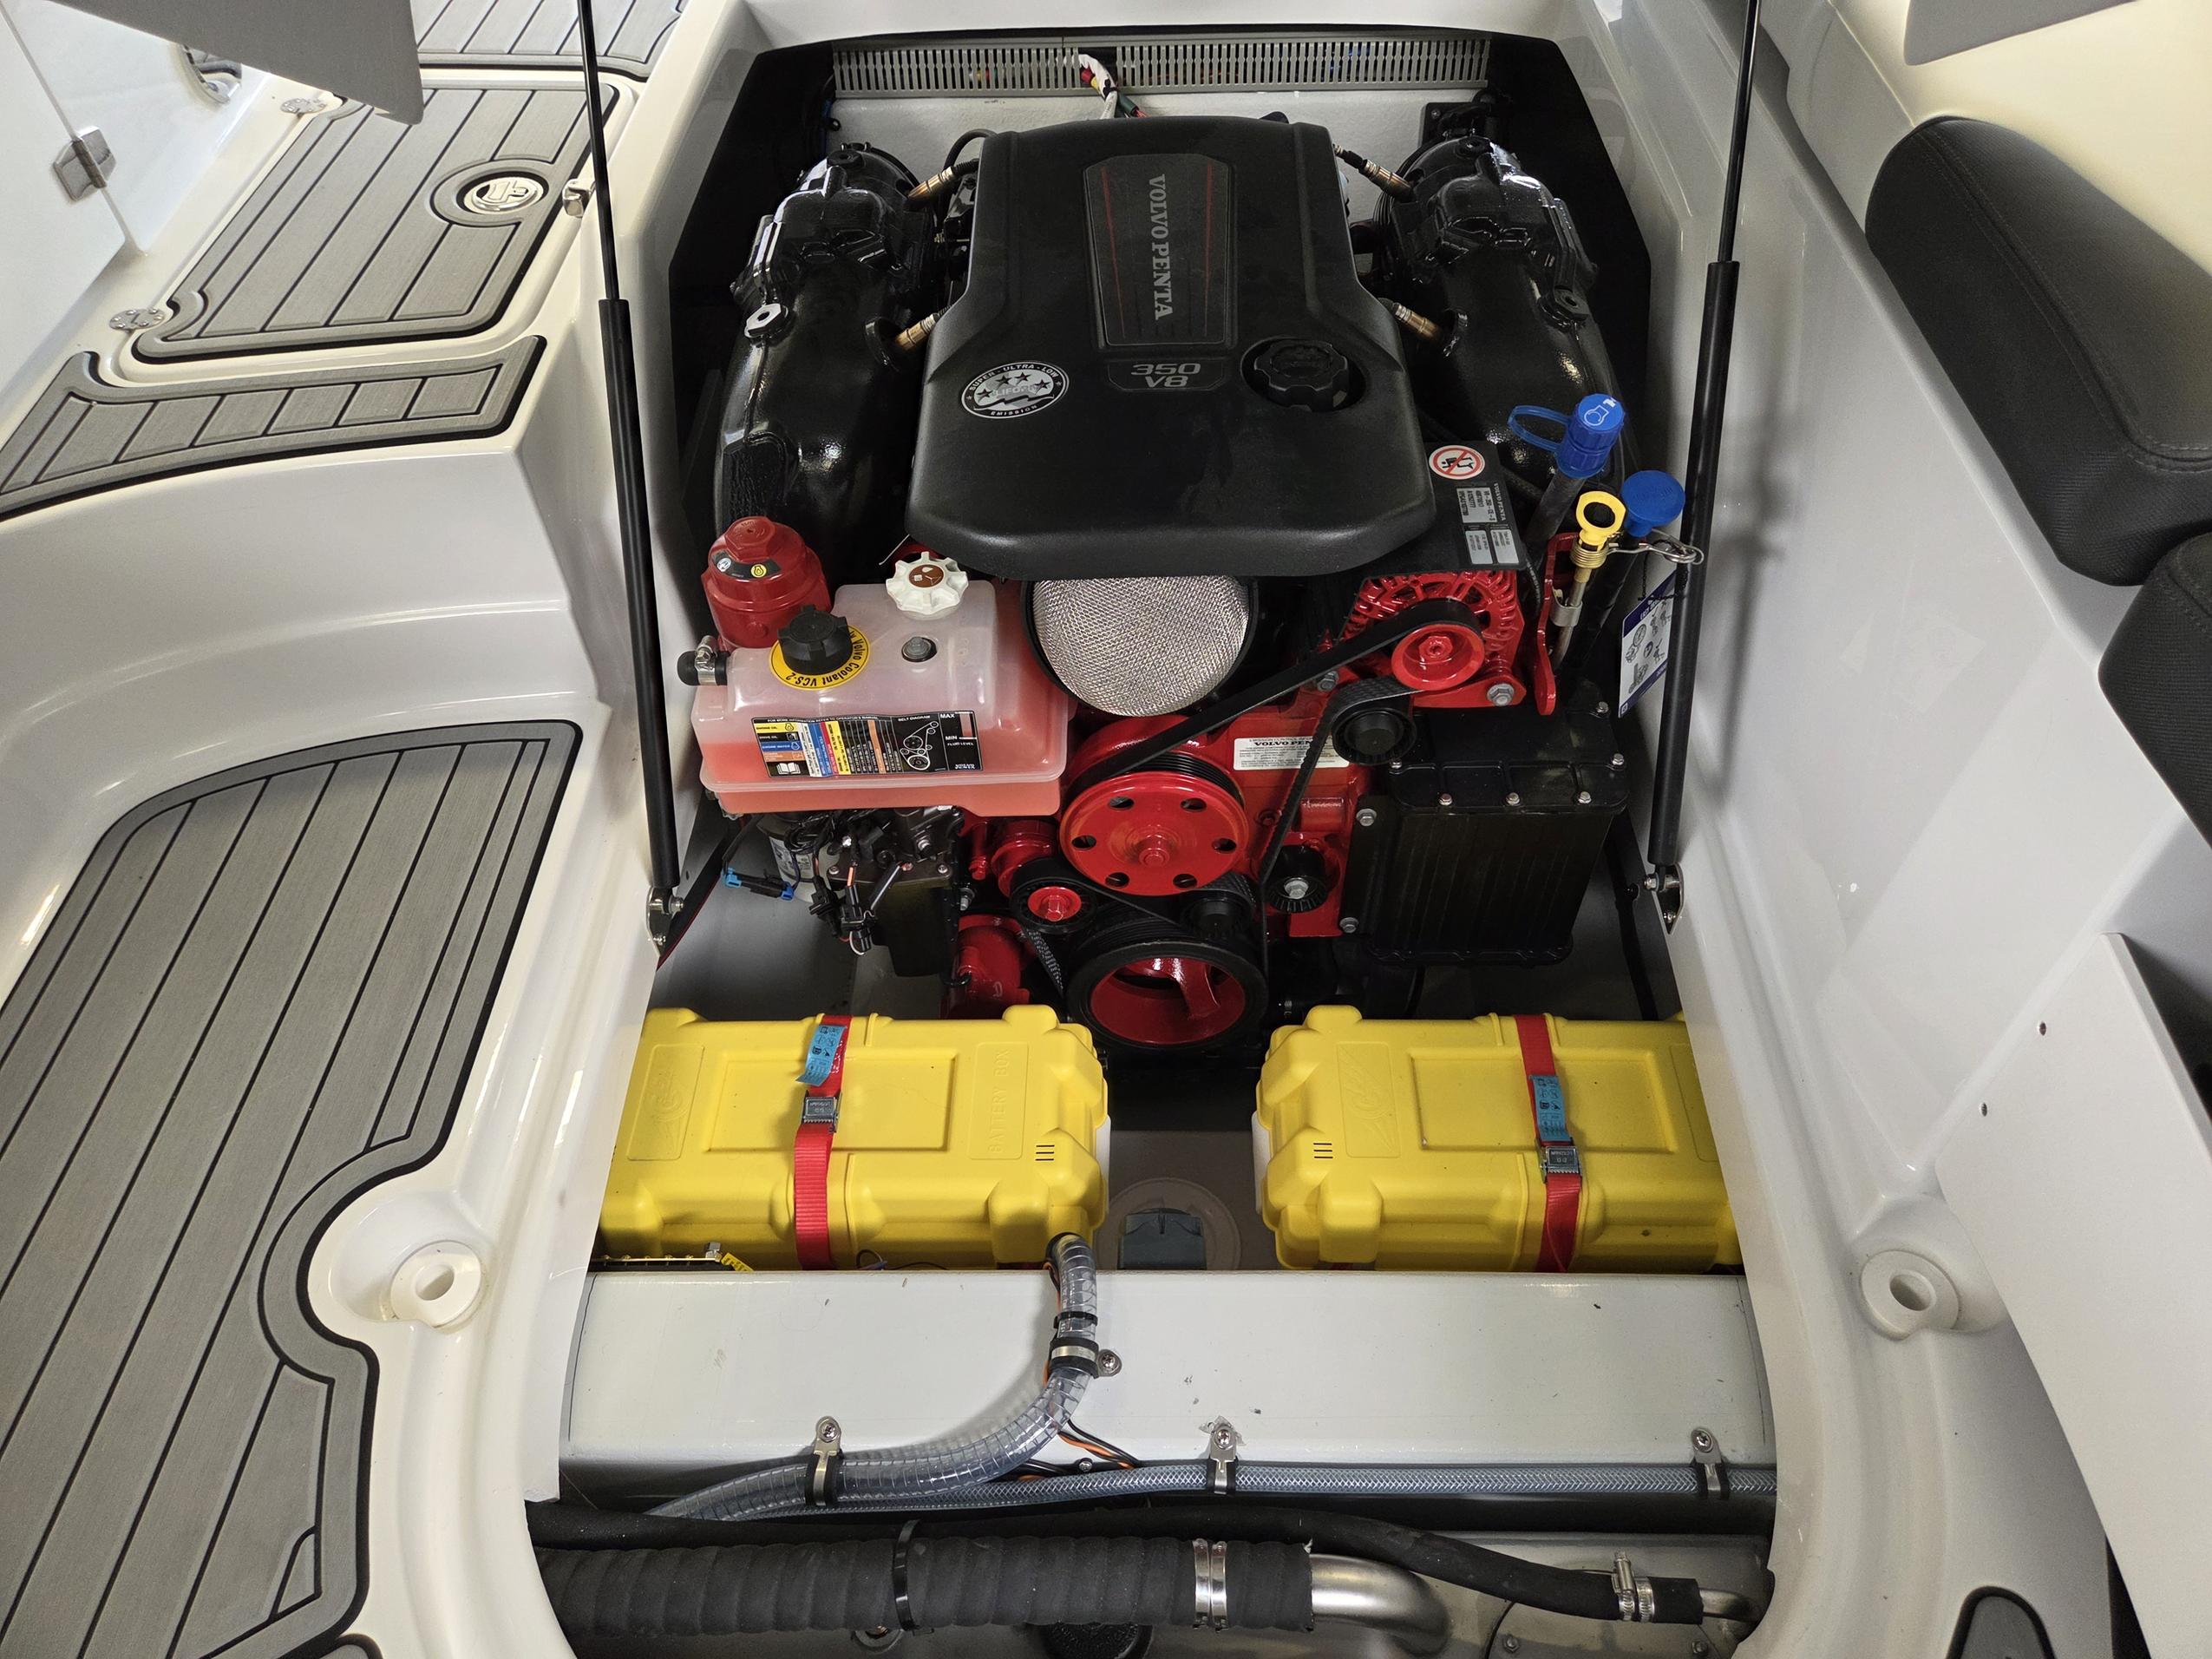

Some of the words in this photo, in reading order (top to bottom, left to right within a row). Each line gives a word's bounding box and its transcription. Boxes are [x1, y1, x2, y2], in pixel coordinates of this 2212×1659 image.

[1149, 174, 1169, 239] VOLVO
[1152, 242, 1174, 320] PENTA
[1041, 366, 1059, 378] LOW
[1130, 363, 1201, 375] 350
[1145, 376, 1189, 388] V8
[990, 405, 1038, 416] EMISSION
[852, 639, 867, 660] Volvo
[785, 672, 817, 686] VCS-2
[822, 662, 860, 685] Coolant
